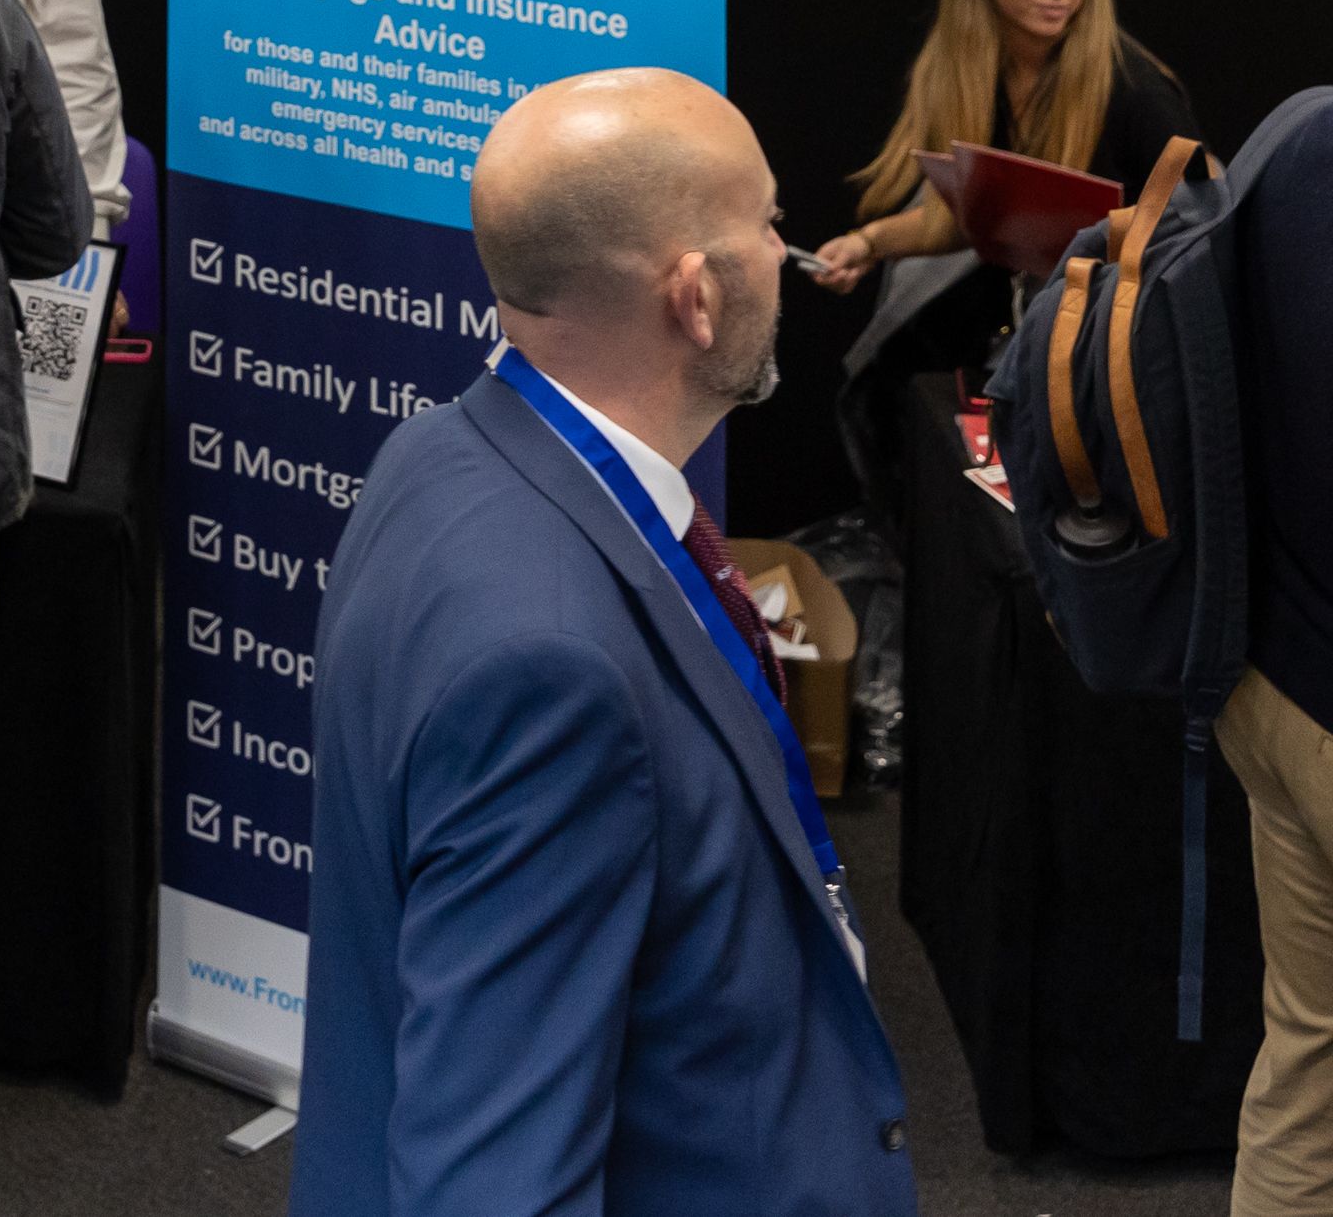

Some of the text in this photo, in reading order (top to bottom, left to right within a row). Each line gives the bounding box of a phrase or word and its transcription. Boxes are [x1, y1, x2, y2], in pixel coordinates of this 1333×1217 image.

[223, 29, 529, 100] for those and their families in
[374, 14, 486, 60] Advice
[245, 65, 503, 125] military, NHS, air ambula
[198, 113, 235, 138] and
[239, 123, 309, 152] across
[313, 131, 339, 156] all
[343, 139, 409, 171] health
[413, 154, 455, 179] and
[271, 99, 483, 153] emergency services
[234, 253, 500, 342] Residential M
[234, 346, 356, 414] Family
[234, 439, 365, 510] Mortga
[234, 533, 330, 591] Buy t
[233, 628, 315, 689] Prop
[233, 720, 316, 780] Inco
[233, 815, 314, 873] Fron
[188, 959, 307, 1018] www.Fron
